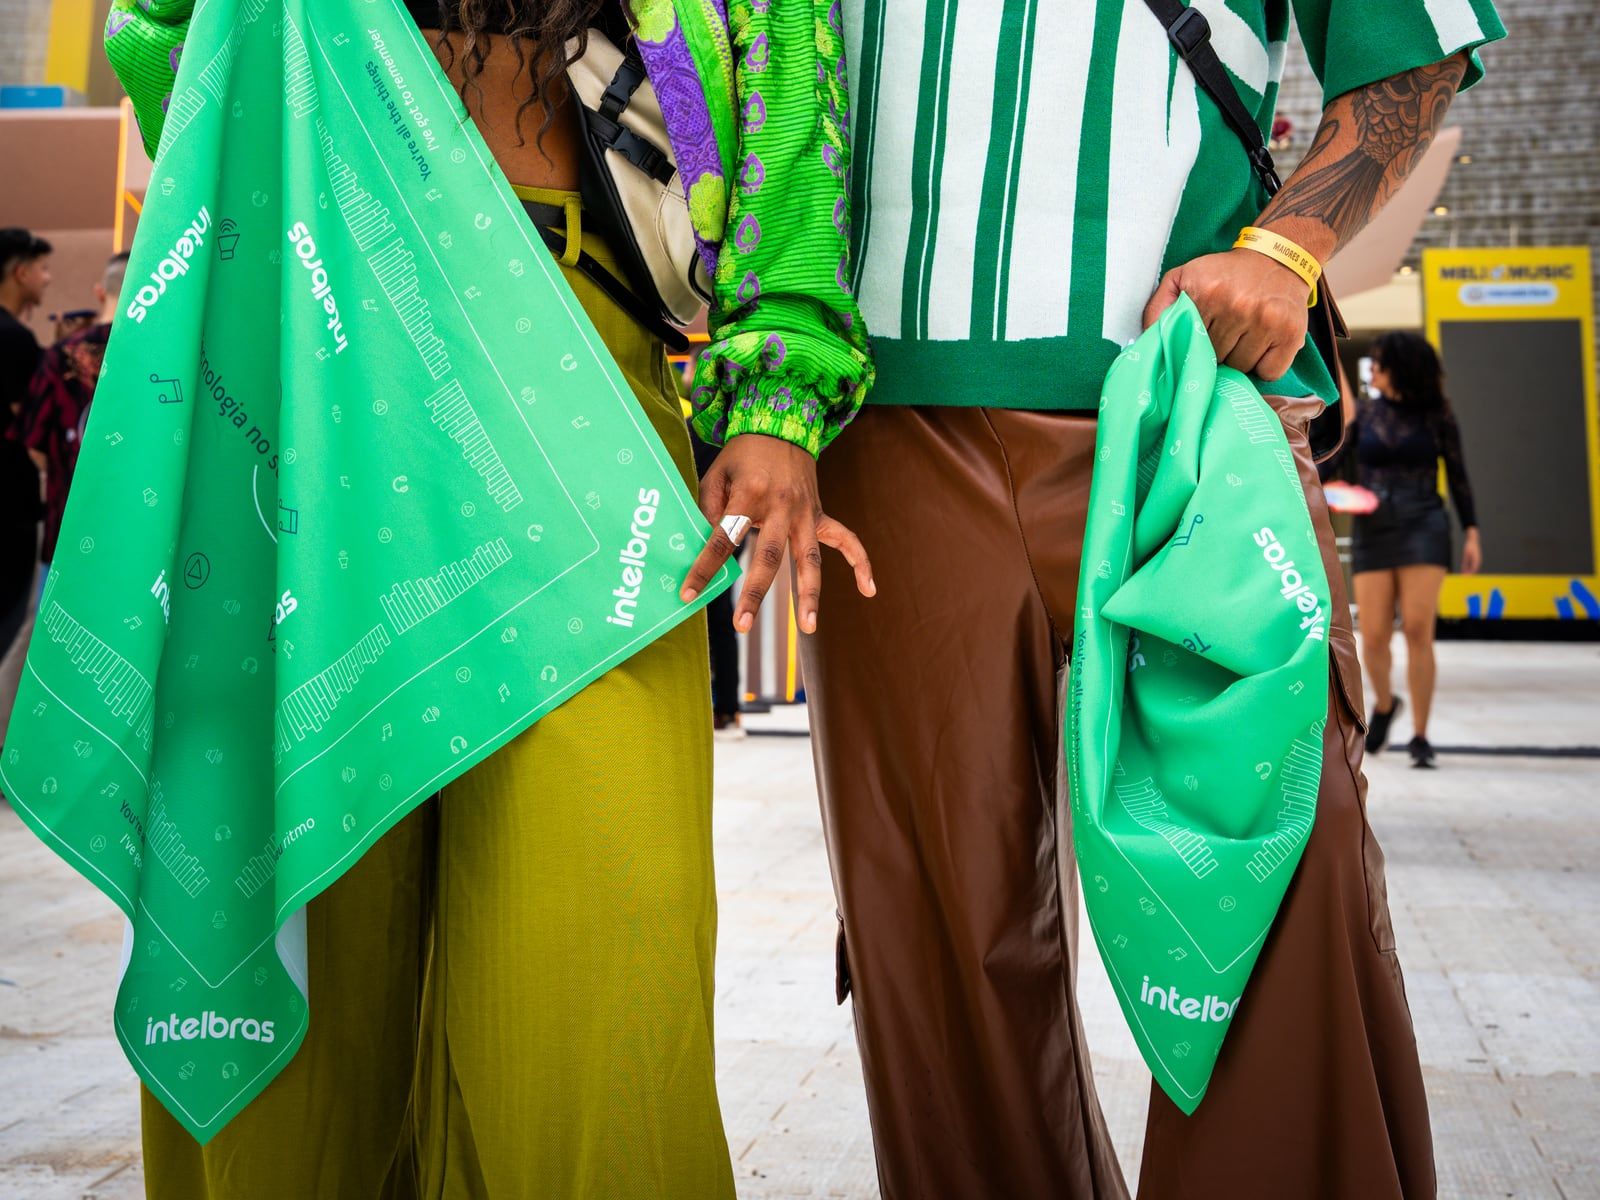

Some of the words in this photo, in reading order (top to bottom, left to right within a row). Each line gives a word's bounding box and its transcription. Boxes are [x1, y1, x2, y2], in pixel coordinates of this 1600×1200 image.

[368, 28, 405, 90] remember
[365, 60, 390, 102] things
[401, 90, 415, 106] to
[386, 102, 402, 125] the
[409, 105, 430, 128] got
[395, 123, 412, 140] all
[422, 129, 440, 151] I've
[407, 140, 432, 181] You're
[127, 205, 212, 324] intelbras
[1272, 242, 1300, 263] MAIORES
[1299, 258, 1308, 269] DE
[1507, 263, 1576, 281] MUSIC
[287, 221, 348, 354] intelbras
[200, 351, 248, 430] nologia
[245, 426, 271, 454] no
[616, 487, 661, 629] intelbras
[282, 817, 316, 849] ritmo
[145, 1010, 275, 1046] intelbras
